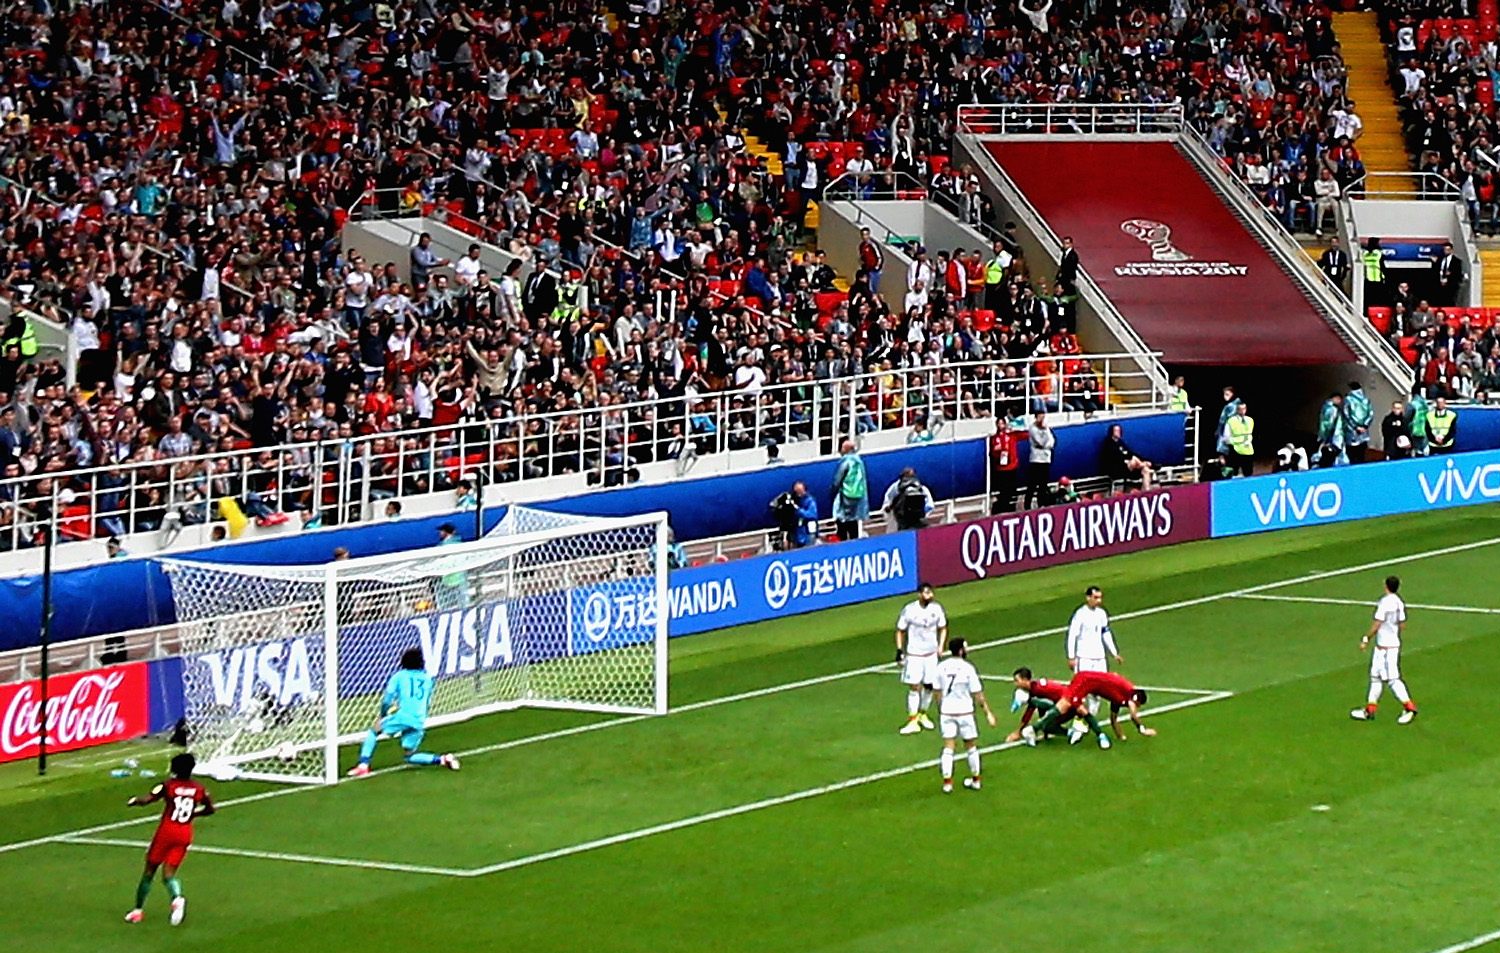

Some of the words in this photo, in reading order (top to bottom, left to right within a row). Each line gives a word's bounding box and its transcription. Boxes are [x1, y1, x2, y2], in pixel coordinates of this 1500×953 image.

[1115, 266, 1199, 276] RUSSIA
[1200, 266, 1248, 276] 2017
[1251, 478, 1341, 525] vivo
[962, 513, 1056, 578] QATAR
[1060, 493, 1171, 553] AIRWAYS
[792, 561, 836, 598] 万达
[833, 548, 904, 588] WANDA
[409, 604, 513, 678] VISA
[201, 637, 319, 712] VISA
[409, 677, 425, 700] 13
[946, 673, 957, 694] 7
[2, 671, 125, 754] Coca-Cola
[171, 795, 195, 823] 18
